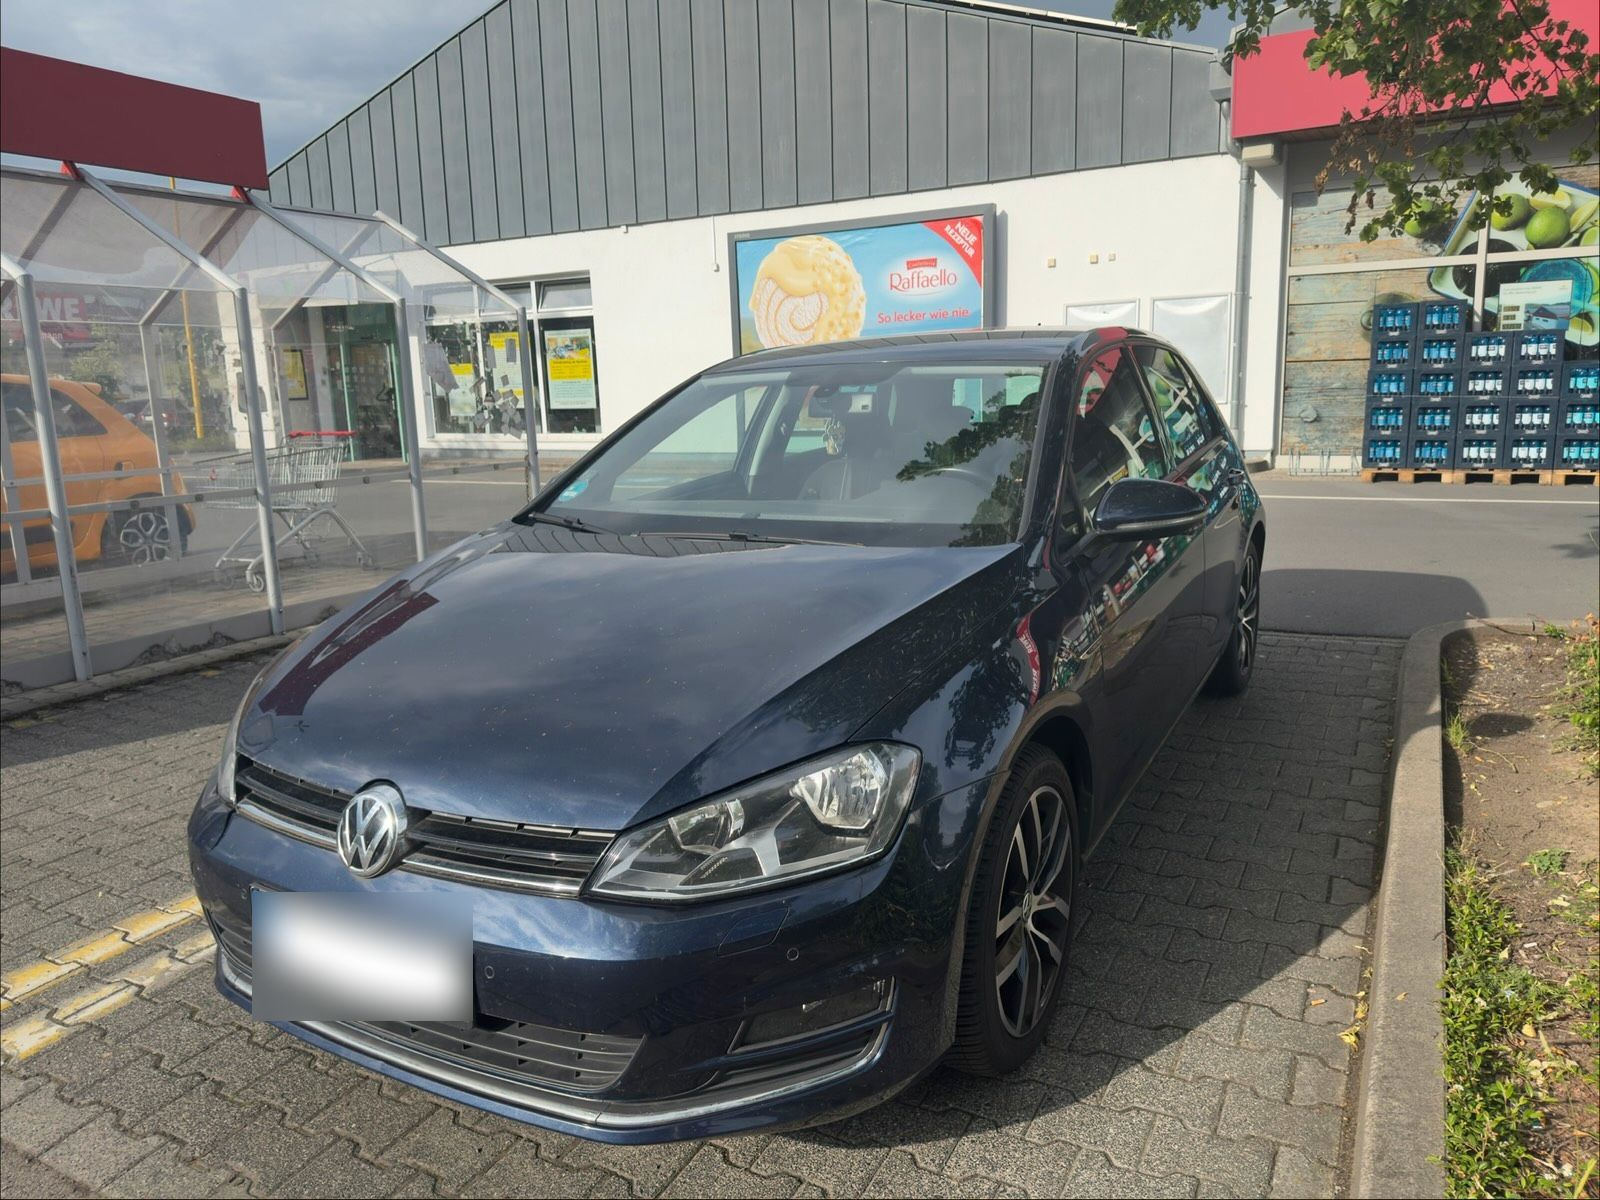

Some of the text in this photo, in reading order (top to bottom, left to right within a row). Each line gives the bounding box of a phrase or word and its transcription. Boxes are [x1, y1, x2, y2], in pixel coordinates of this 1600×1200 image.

[945, 224, 976, 257] REZEPTUR
[955, 221, 977, 245] NEUE
[890, 268, 957, 292] Raffaello
[878, 307, 969, 324] So lecker wie nie
